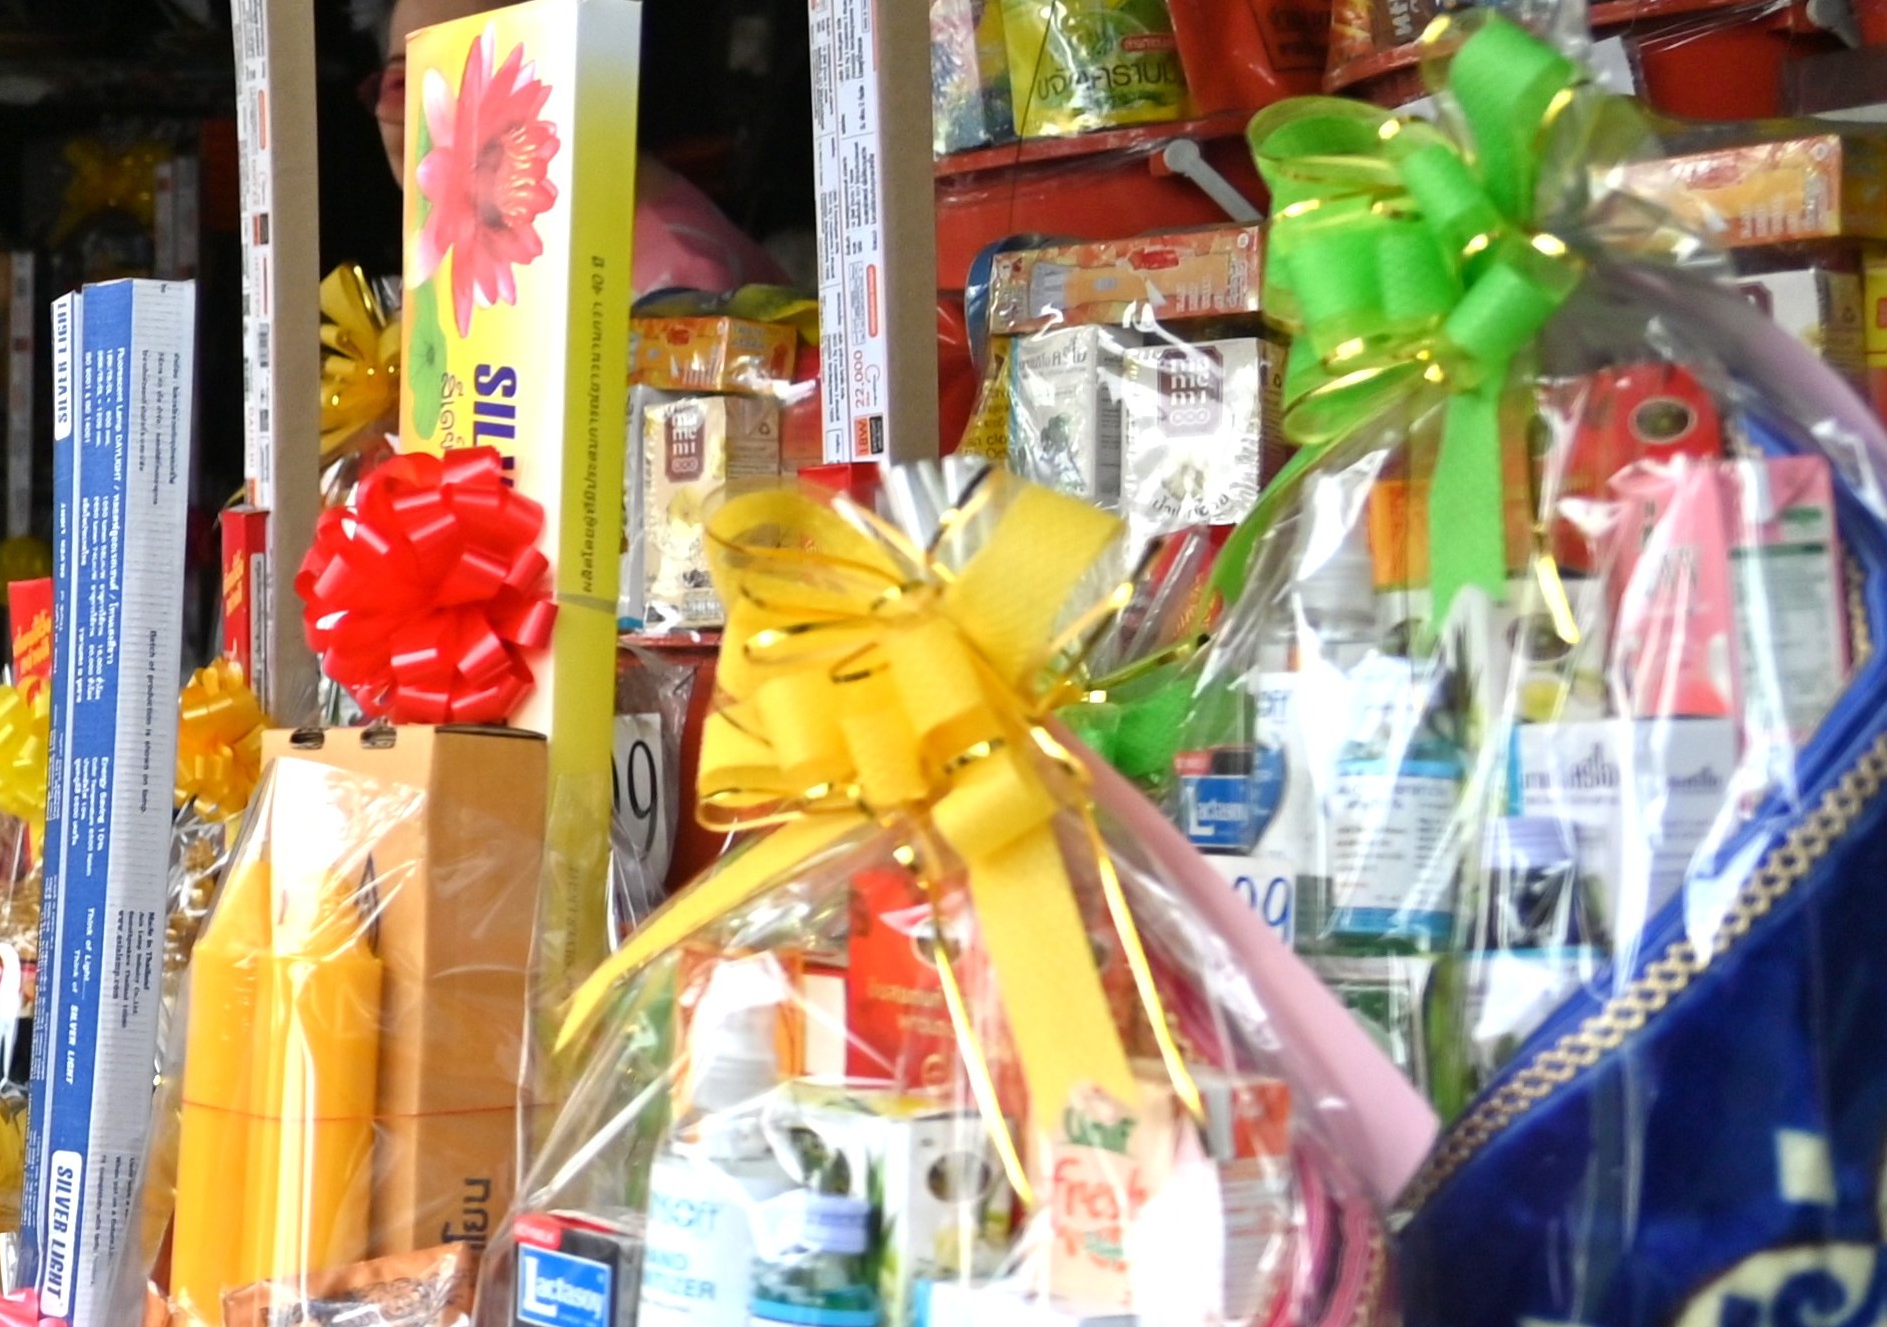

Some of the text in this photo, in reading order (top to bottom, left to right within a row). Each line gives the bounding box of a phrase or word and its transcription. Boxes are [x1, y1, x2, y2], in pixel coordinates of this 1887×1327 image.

[56, 302, 69, 424] SILVER LIGHT
[115, 347, 126, 403] Fluorescent
[853, 350, 866, 409] 22,000
[114, 404, 125, 433] Lamp
[856, 421, 869, 453] 18W
[113, 434, 124, 482] DAYLIGHT
[148, 629, 157, 657] Batch
[143, 674, 156, 725] production
[142, 739, 152, 770] shown
[98, 756, 110, 790] Energy
[96, 791, 108, 824] Saving
[85, 907, 95, 936] Think
[146, 911, 156, 937] Made
[72, 948, 81, 978] Think
[143, 951, 154, 991] Thailand
[67, 1004, 79, 1046] SILVER
[64, 1049, 76, 1085] LIGHT
[46, 1164, 73, 1300] SILVER LIGHT
[522, 1254, 604, 1321] Lactasoy
